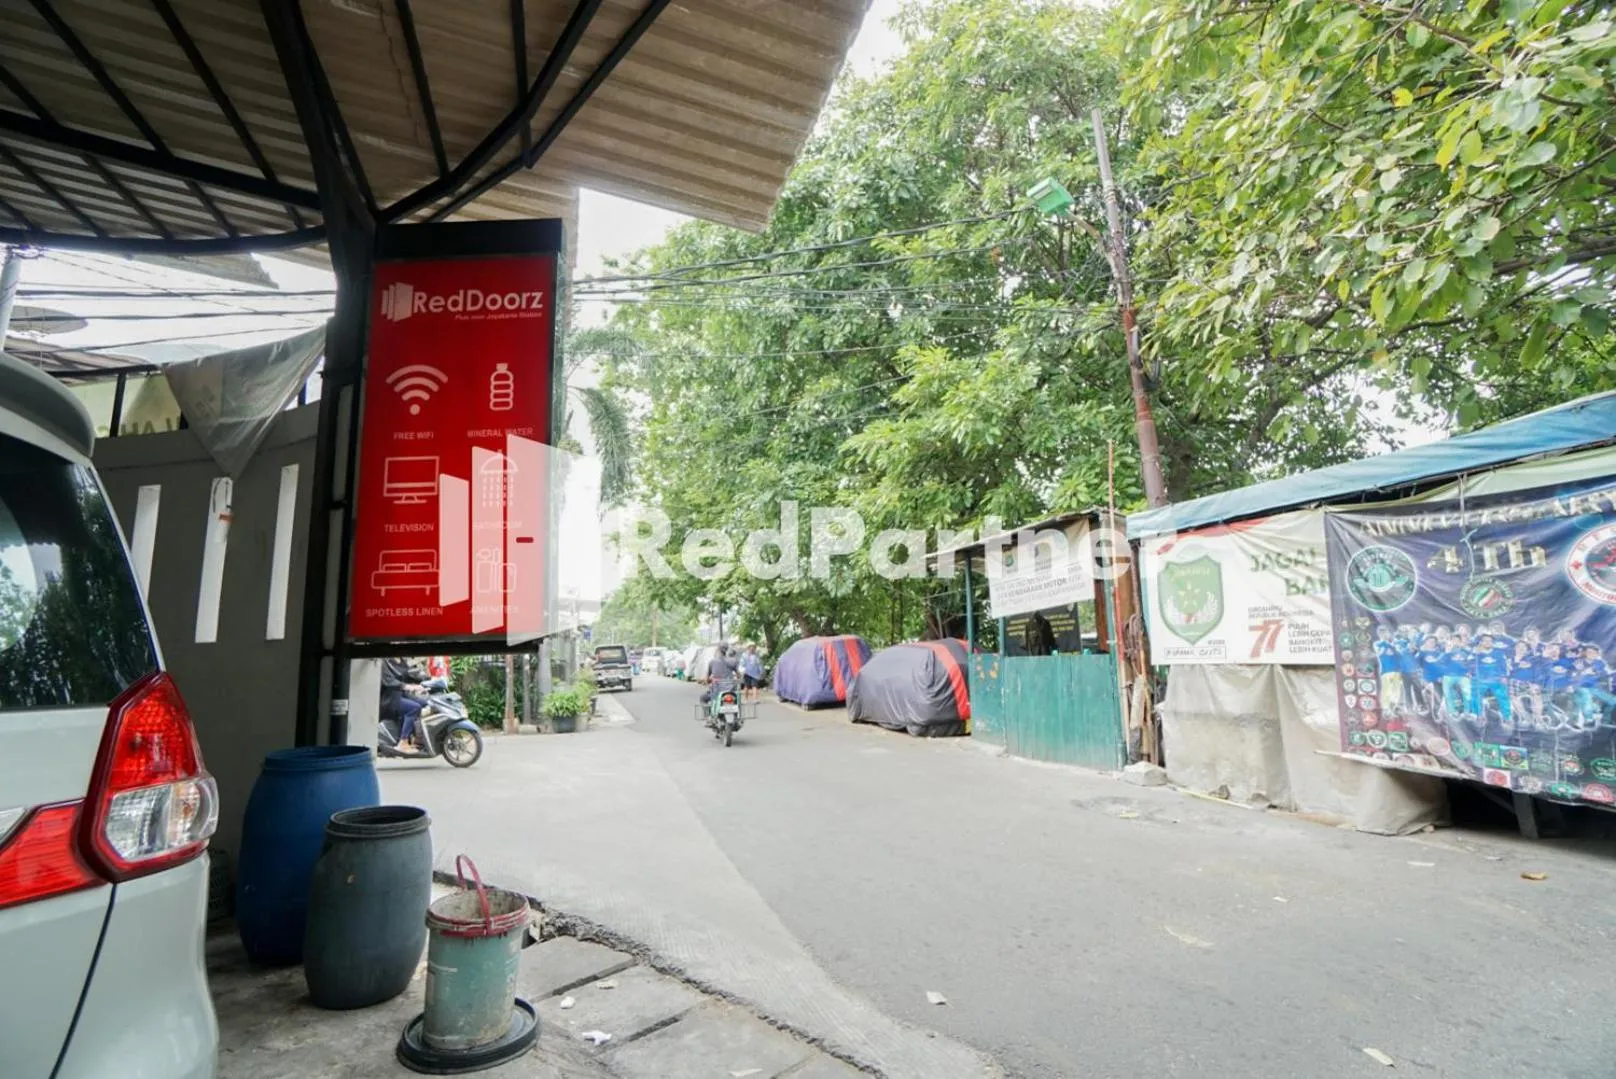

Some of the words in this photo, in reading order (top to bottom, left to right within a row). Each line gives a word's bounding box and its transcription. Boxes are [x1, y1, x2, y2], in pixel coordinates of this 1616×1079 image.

[413, 289, 543, 313] RedDoorz
[393, 432, 415, 440] FREE
[416, 431, 434, 440] WIFI
[467, 429, 503, 438] MINERAL
[505, 427, 533, 436] WATER
[384, 523, 434, 533] TELEVISION
[366, 608, 414, 618] SPOTLESS
[416, 607, 444, 616] LINEN
